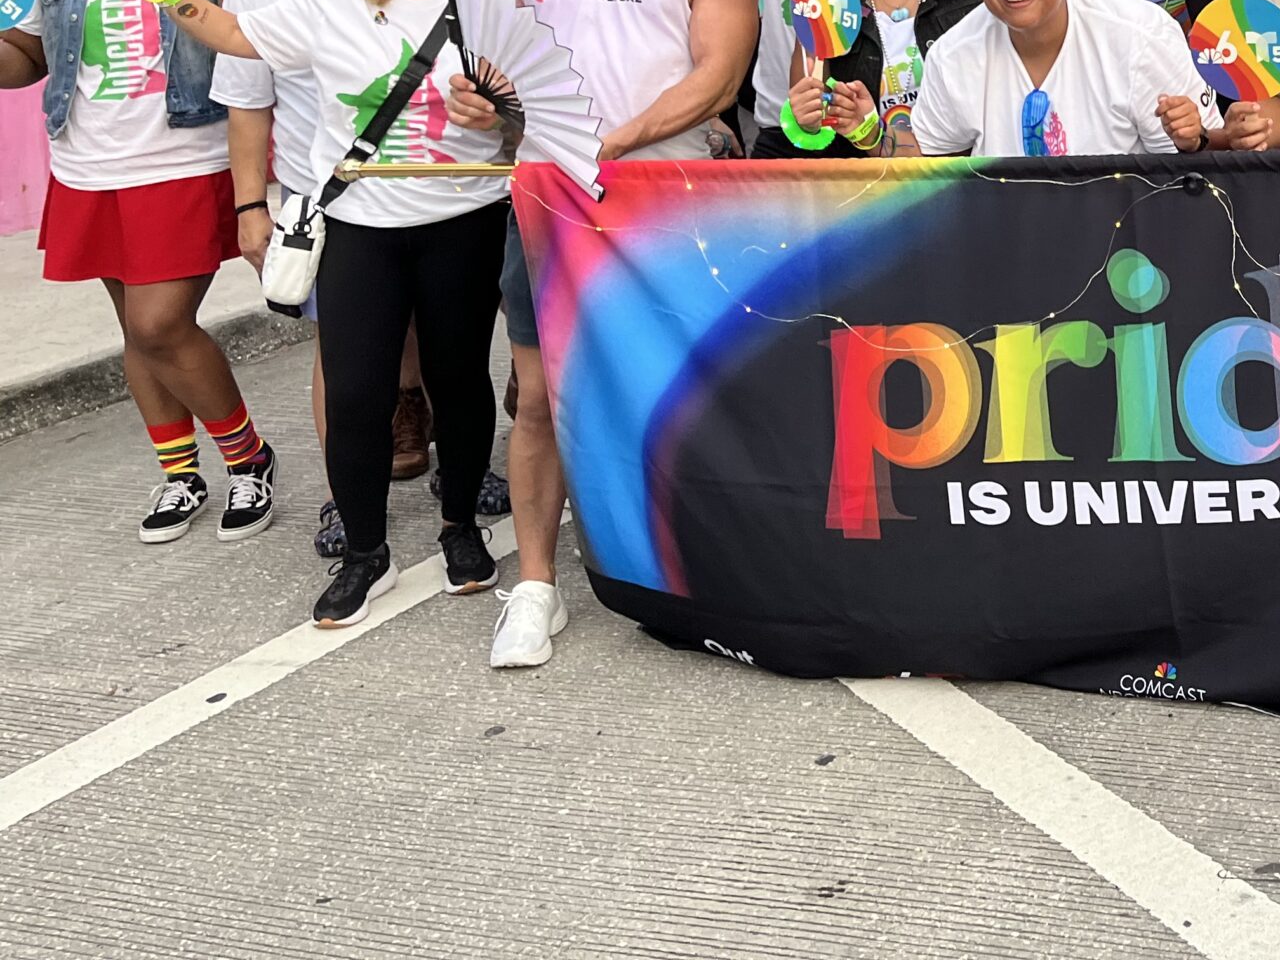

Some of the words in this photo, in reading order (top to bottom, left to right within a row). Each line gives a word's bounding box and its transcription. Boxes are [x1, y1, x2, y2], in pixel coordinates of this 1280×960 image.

[882, 98, 897, 110] IS
[946, 480, 1011, 526] IS
[1119, 674, 1207, 702] COMCAST
